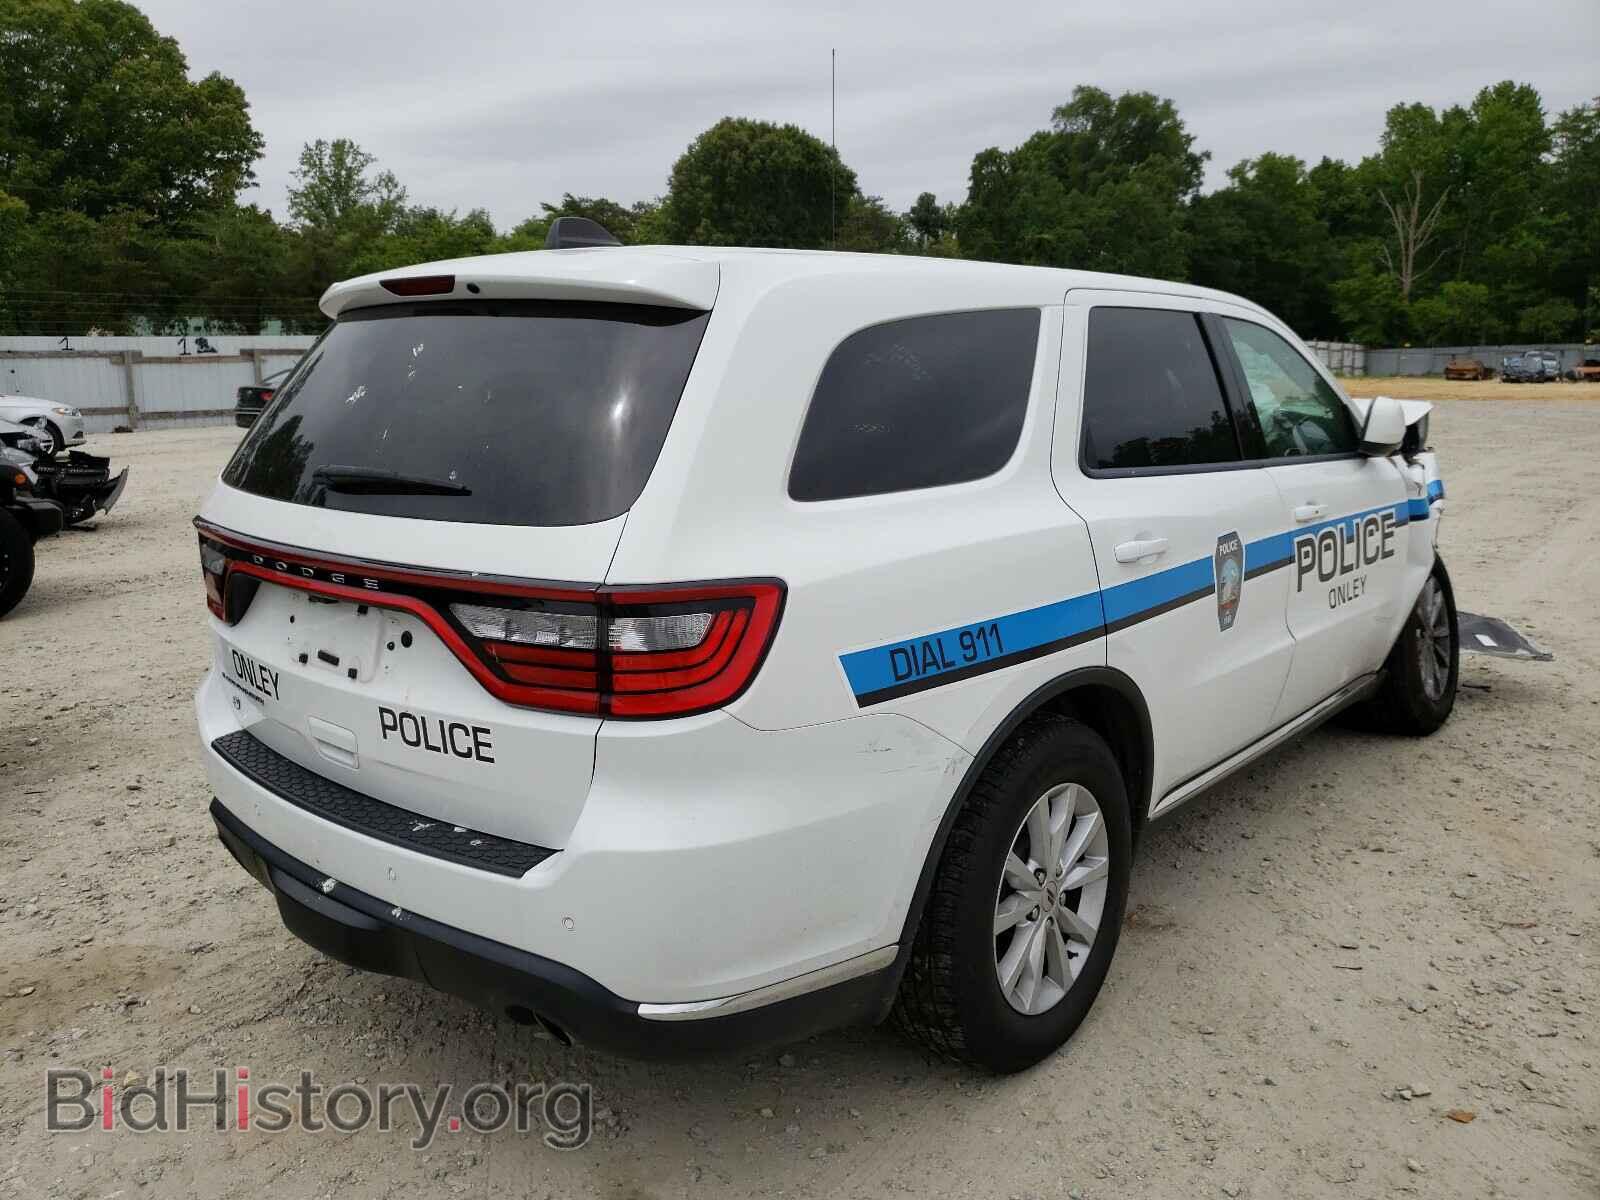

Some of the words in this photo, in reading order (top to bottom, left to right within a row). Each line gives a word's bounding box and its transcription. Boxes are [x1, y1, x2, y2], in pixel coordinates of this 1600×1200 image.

[252, 553, 380, 591] DODGE
[1219, 540, 1239, 557] POLICE
[1295, 510, 1397, 593] POLICE
[1328, 574, 1368, 610] ONLEY
[231, 648, 280, 701] ONLEY
[889, 637, 957, 682] DIAL
[958, 623, 1005, 663] 911
[378, 705, 496, 765] POLICE
